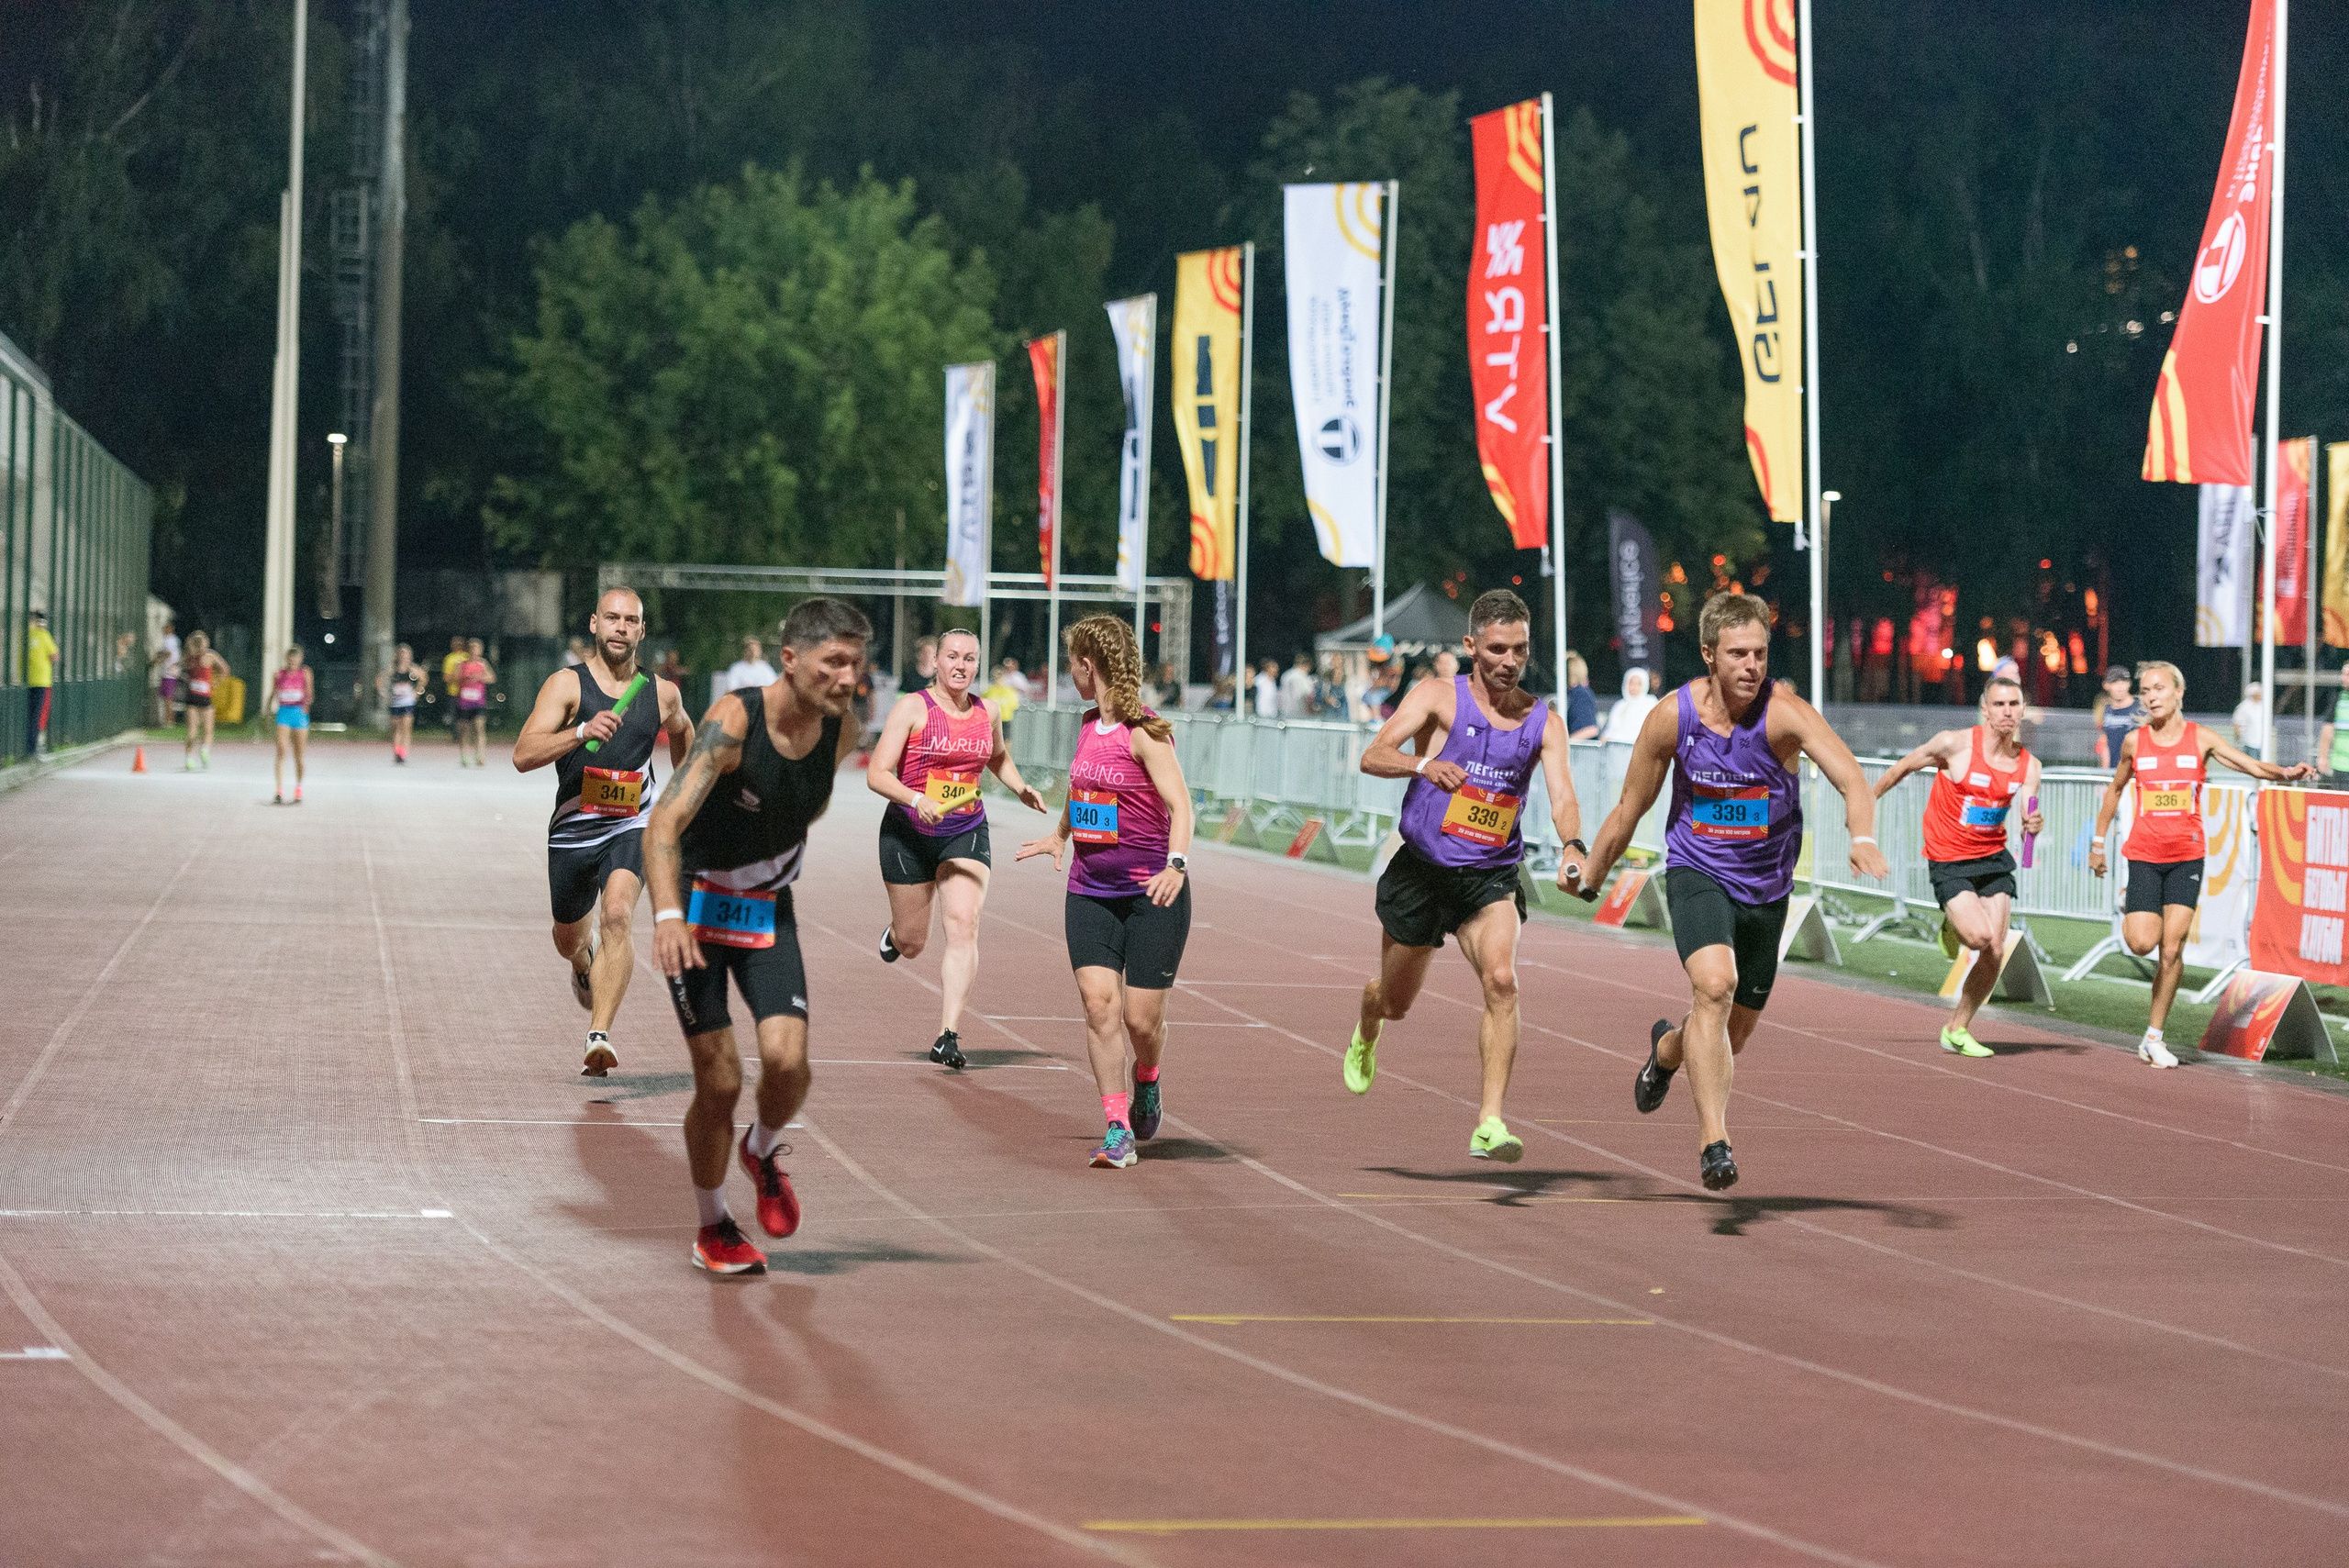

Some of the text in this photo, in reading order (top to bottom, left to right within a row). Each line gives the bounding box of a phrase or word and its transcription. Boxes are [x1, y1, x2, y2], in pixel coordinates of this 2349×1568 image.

[600, 784, 636, 802] 341 2
[2154, 794, 2177, 806] 336
[1075, 806, 1110, 827] 340 3
[1467, 806, 1508, 830] 339 2
[1712, 804, 1760, 822] 339 3
[716, 900, 751, 926] 341
